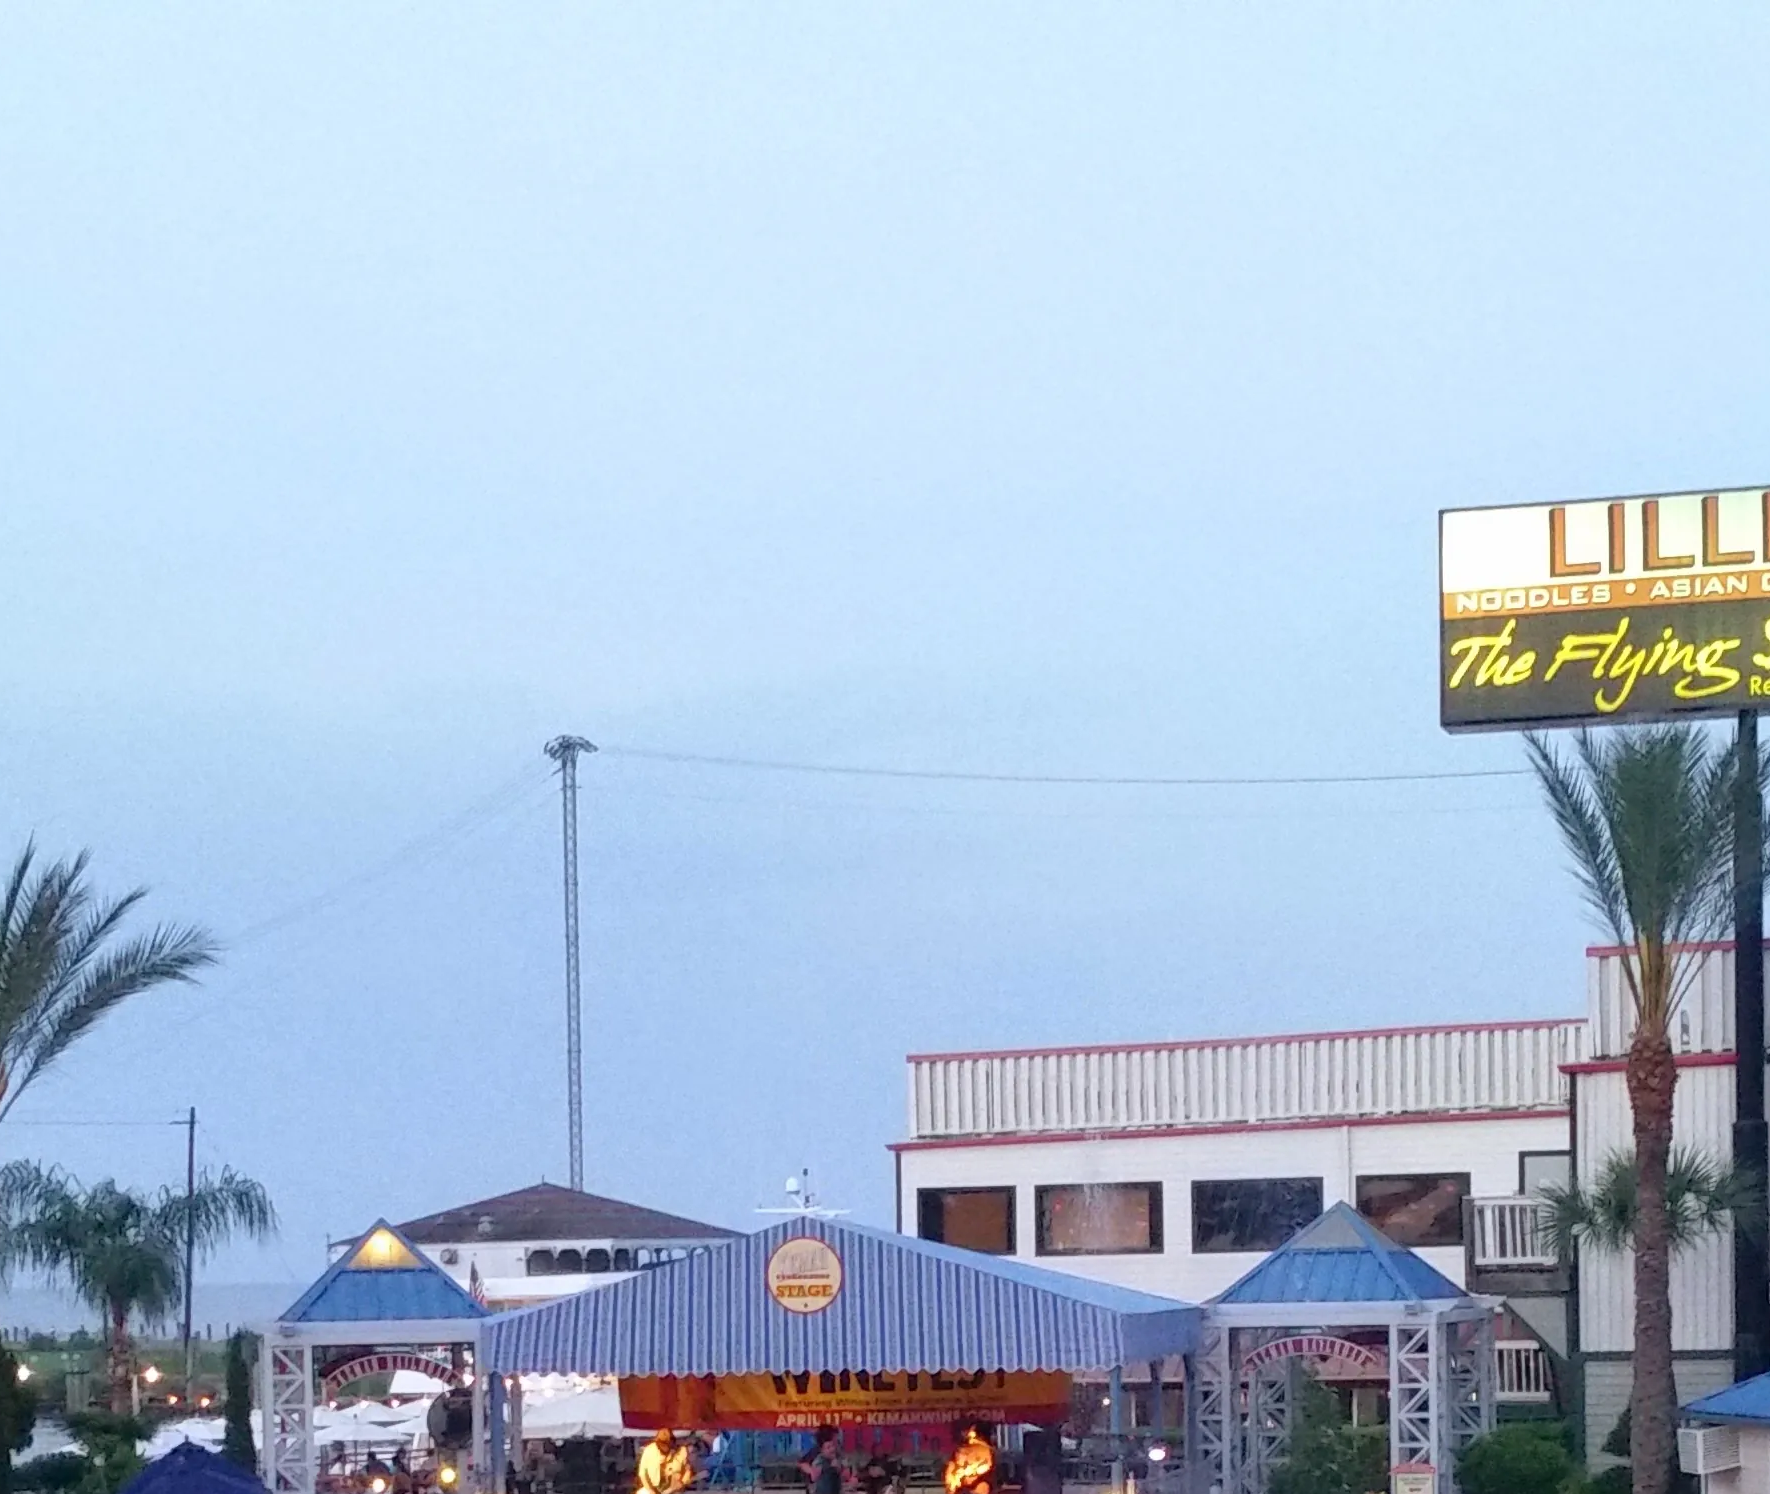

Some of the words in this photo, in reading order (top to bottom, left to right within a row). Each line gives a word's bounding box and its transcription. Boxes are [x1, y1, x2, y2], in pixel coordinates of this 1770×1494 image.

[1455, 584, 1612, 613] NOODLES
[1650, 574, 1749, 600] ASIAN
[1448, 617, 1537, 689] The
[1543, 616, 1741, 713] Flying
[775, 1284, 834, 1298] STAGE
[775, 1413, 821, 1428] APRIL
